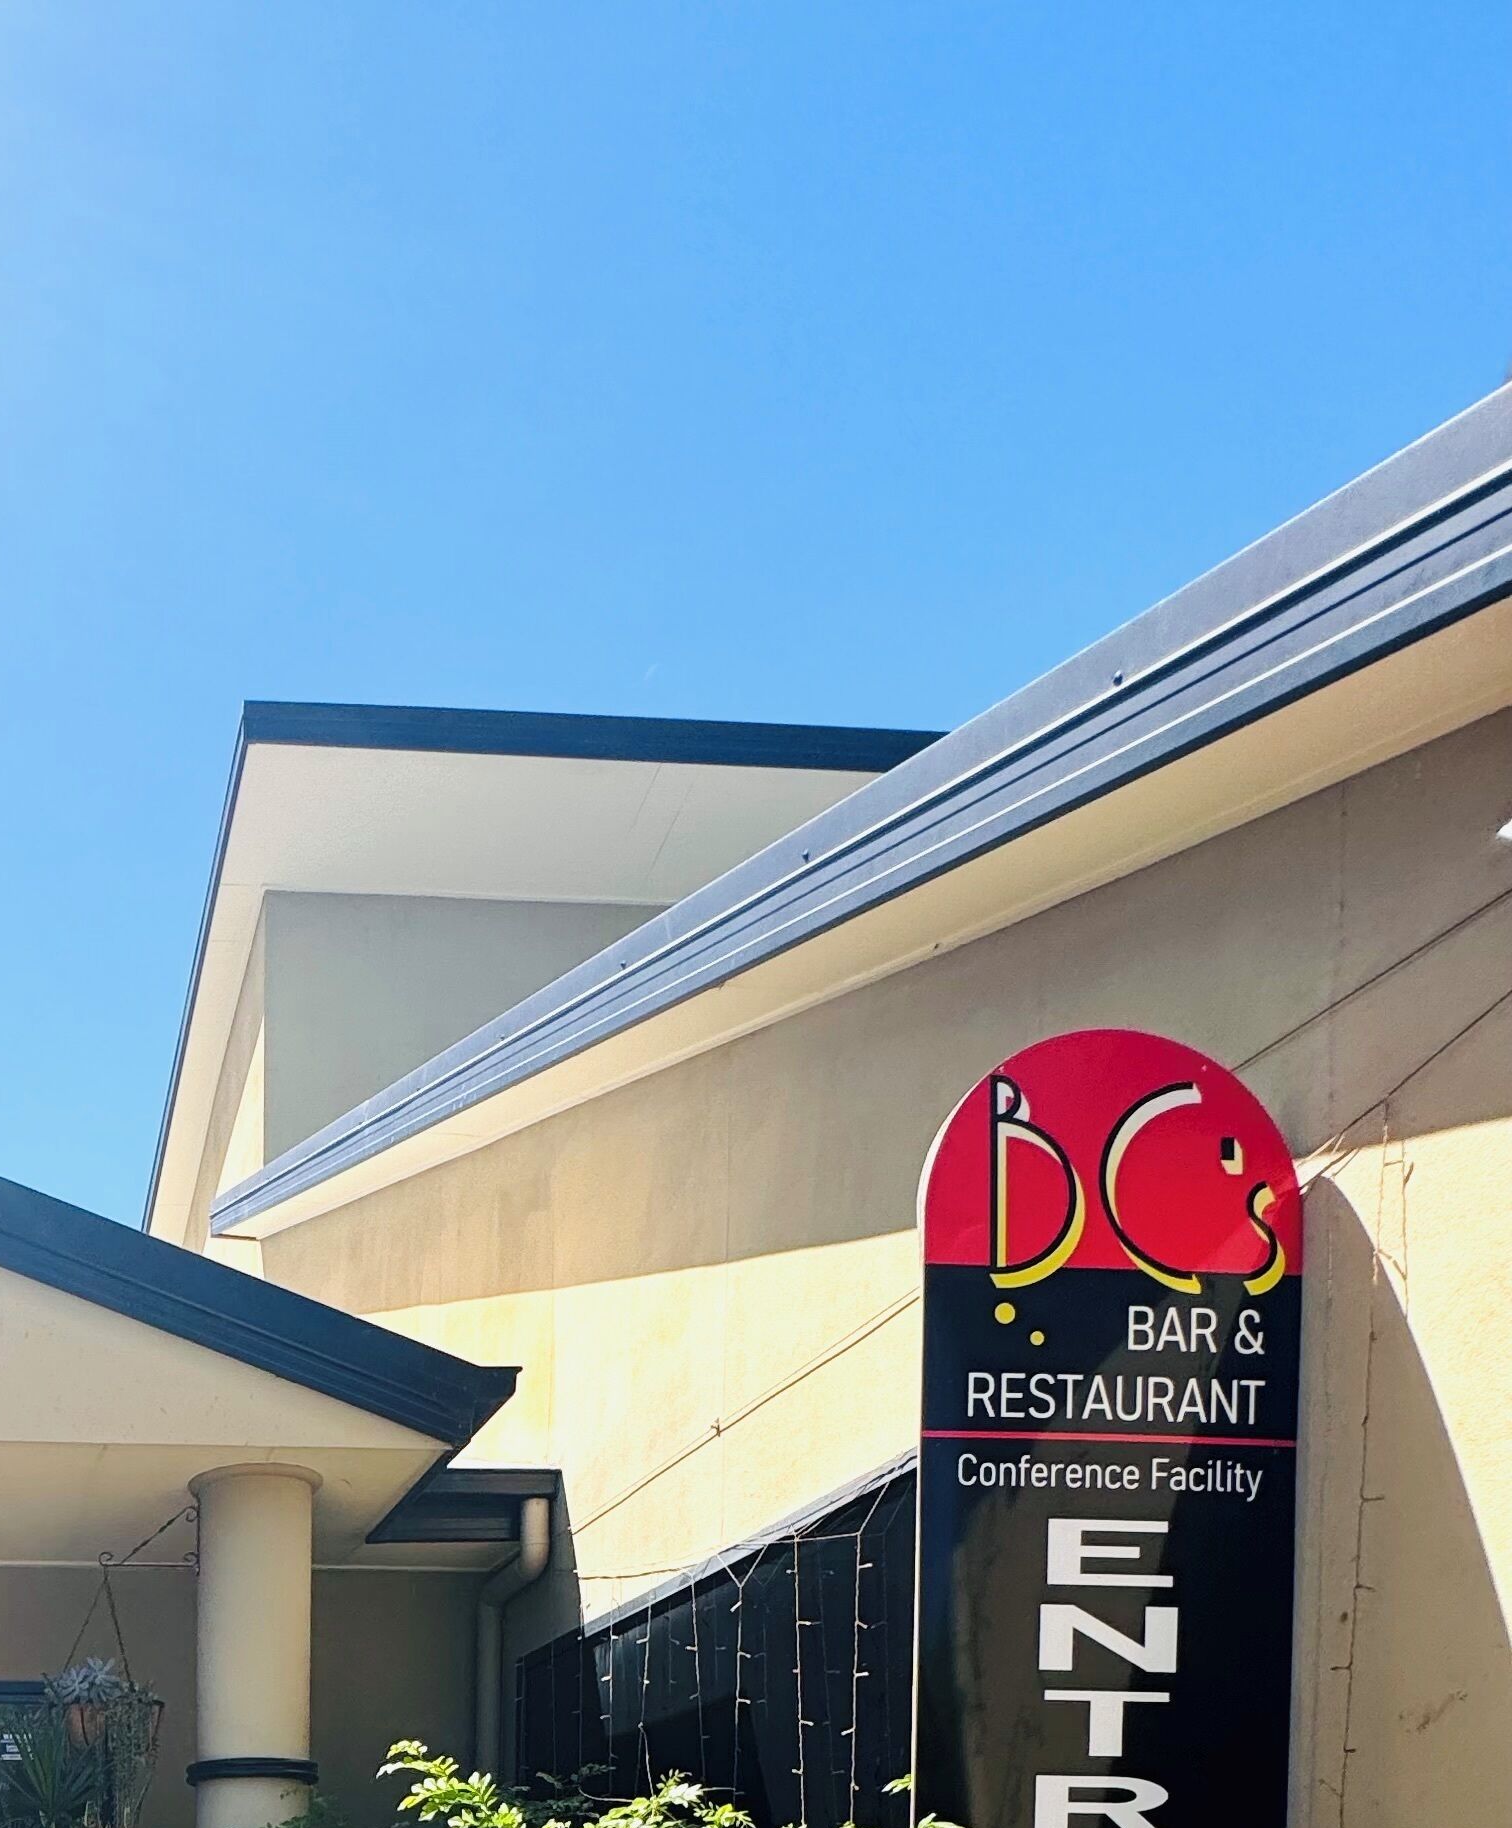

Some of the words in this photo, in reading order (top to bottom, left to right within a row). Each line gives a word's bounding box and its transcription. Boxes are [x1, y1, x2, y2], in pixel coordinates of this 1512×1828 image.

[989, 1074, 1287, 1296] BC's
[1127, 1305, 1218, 1354] BAR
[1234, 1308, 1266, 1356] &
[966, 1371, 1267, 1426] RESTAURANT
[957, 1453, 1140, 1490] Conference
[1151, 1457, 1264, 1503] Facility
